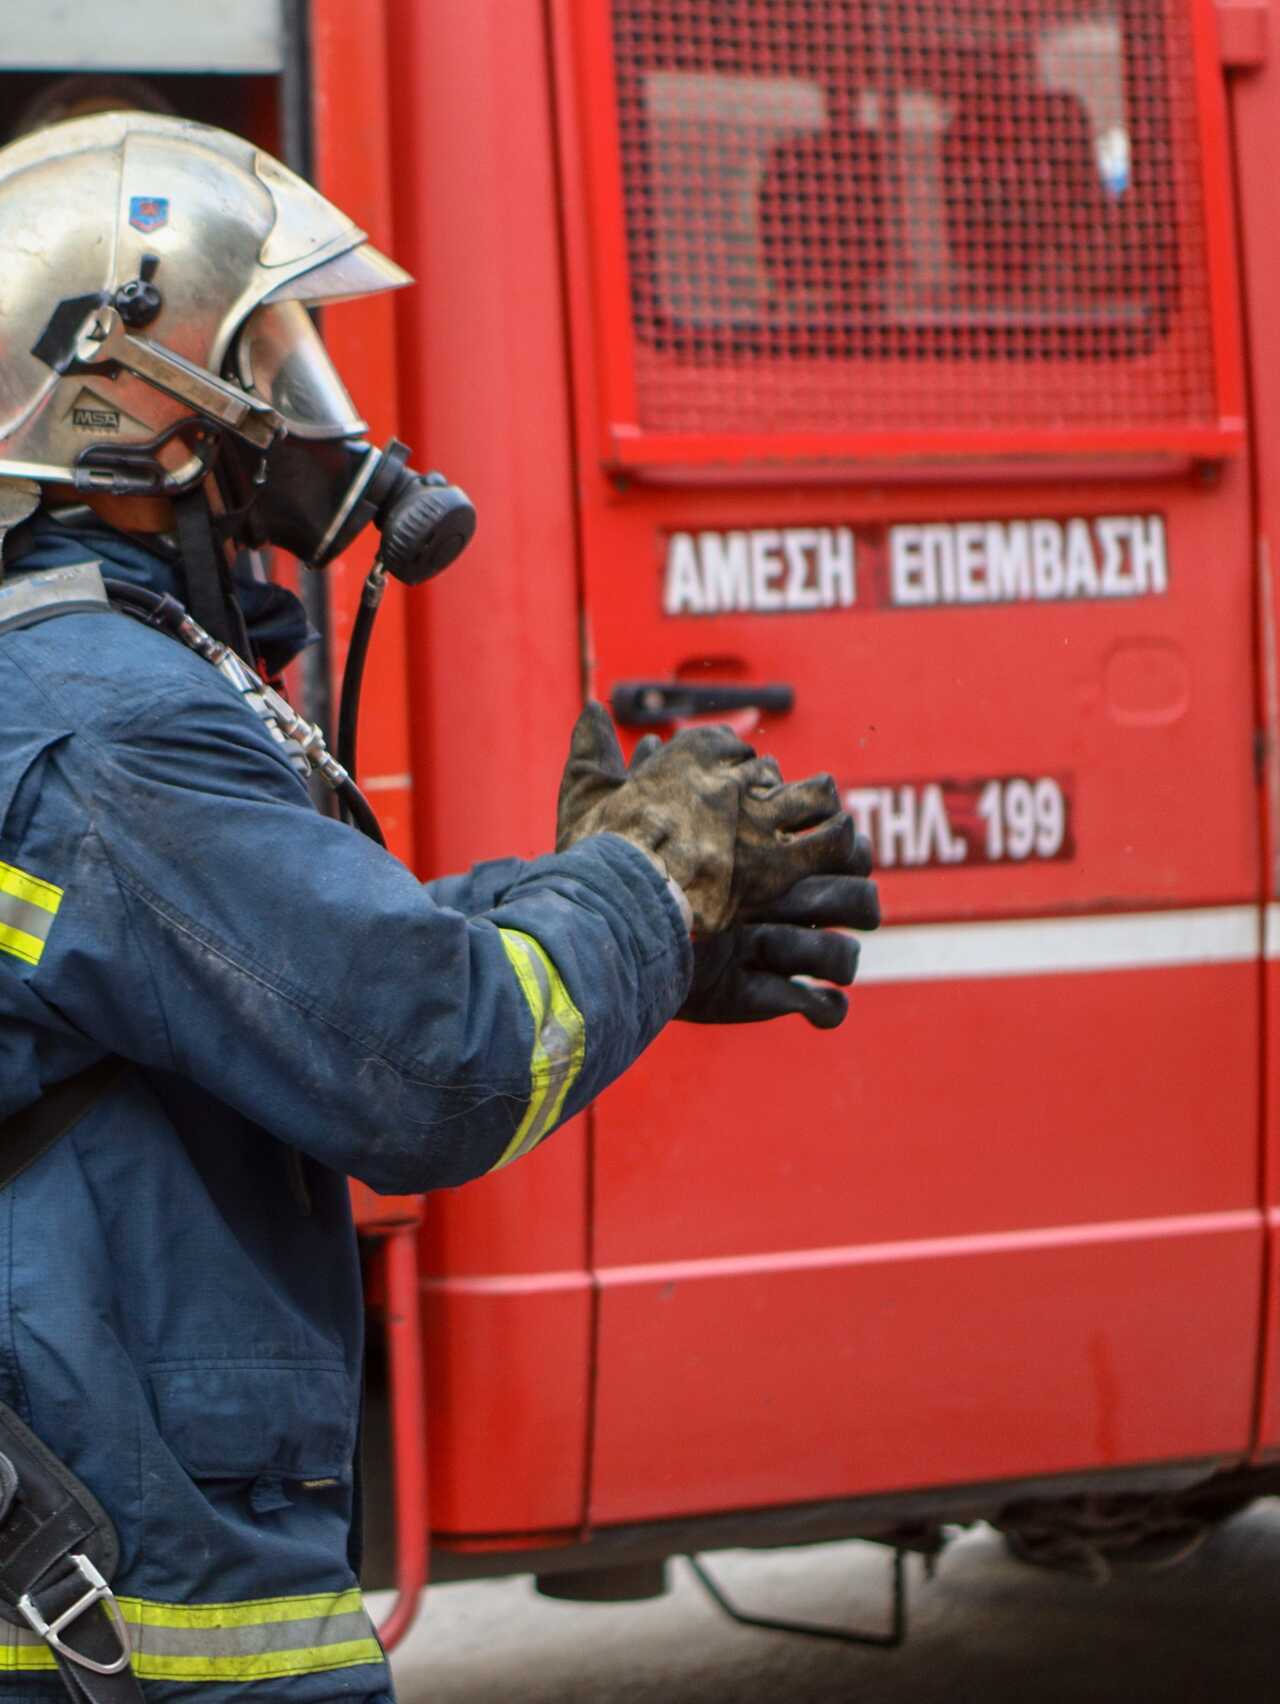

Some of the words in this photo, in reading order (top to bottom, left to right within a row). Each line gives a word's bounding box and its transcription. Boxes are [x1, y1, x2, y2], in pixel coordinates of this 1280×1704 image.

[75, 410, 118, 426] MSA
[666, 527, 857, 616] ΑΜΕΣΗ
[890, 514, 1167, 605] ΕΠΕΜΒΑΣΗ
[847, 782, 968, 868] ΤΗΛ.
[978, 779, 1065, 860] 199
